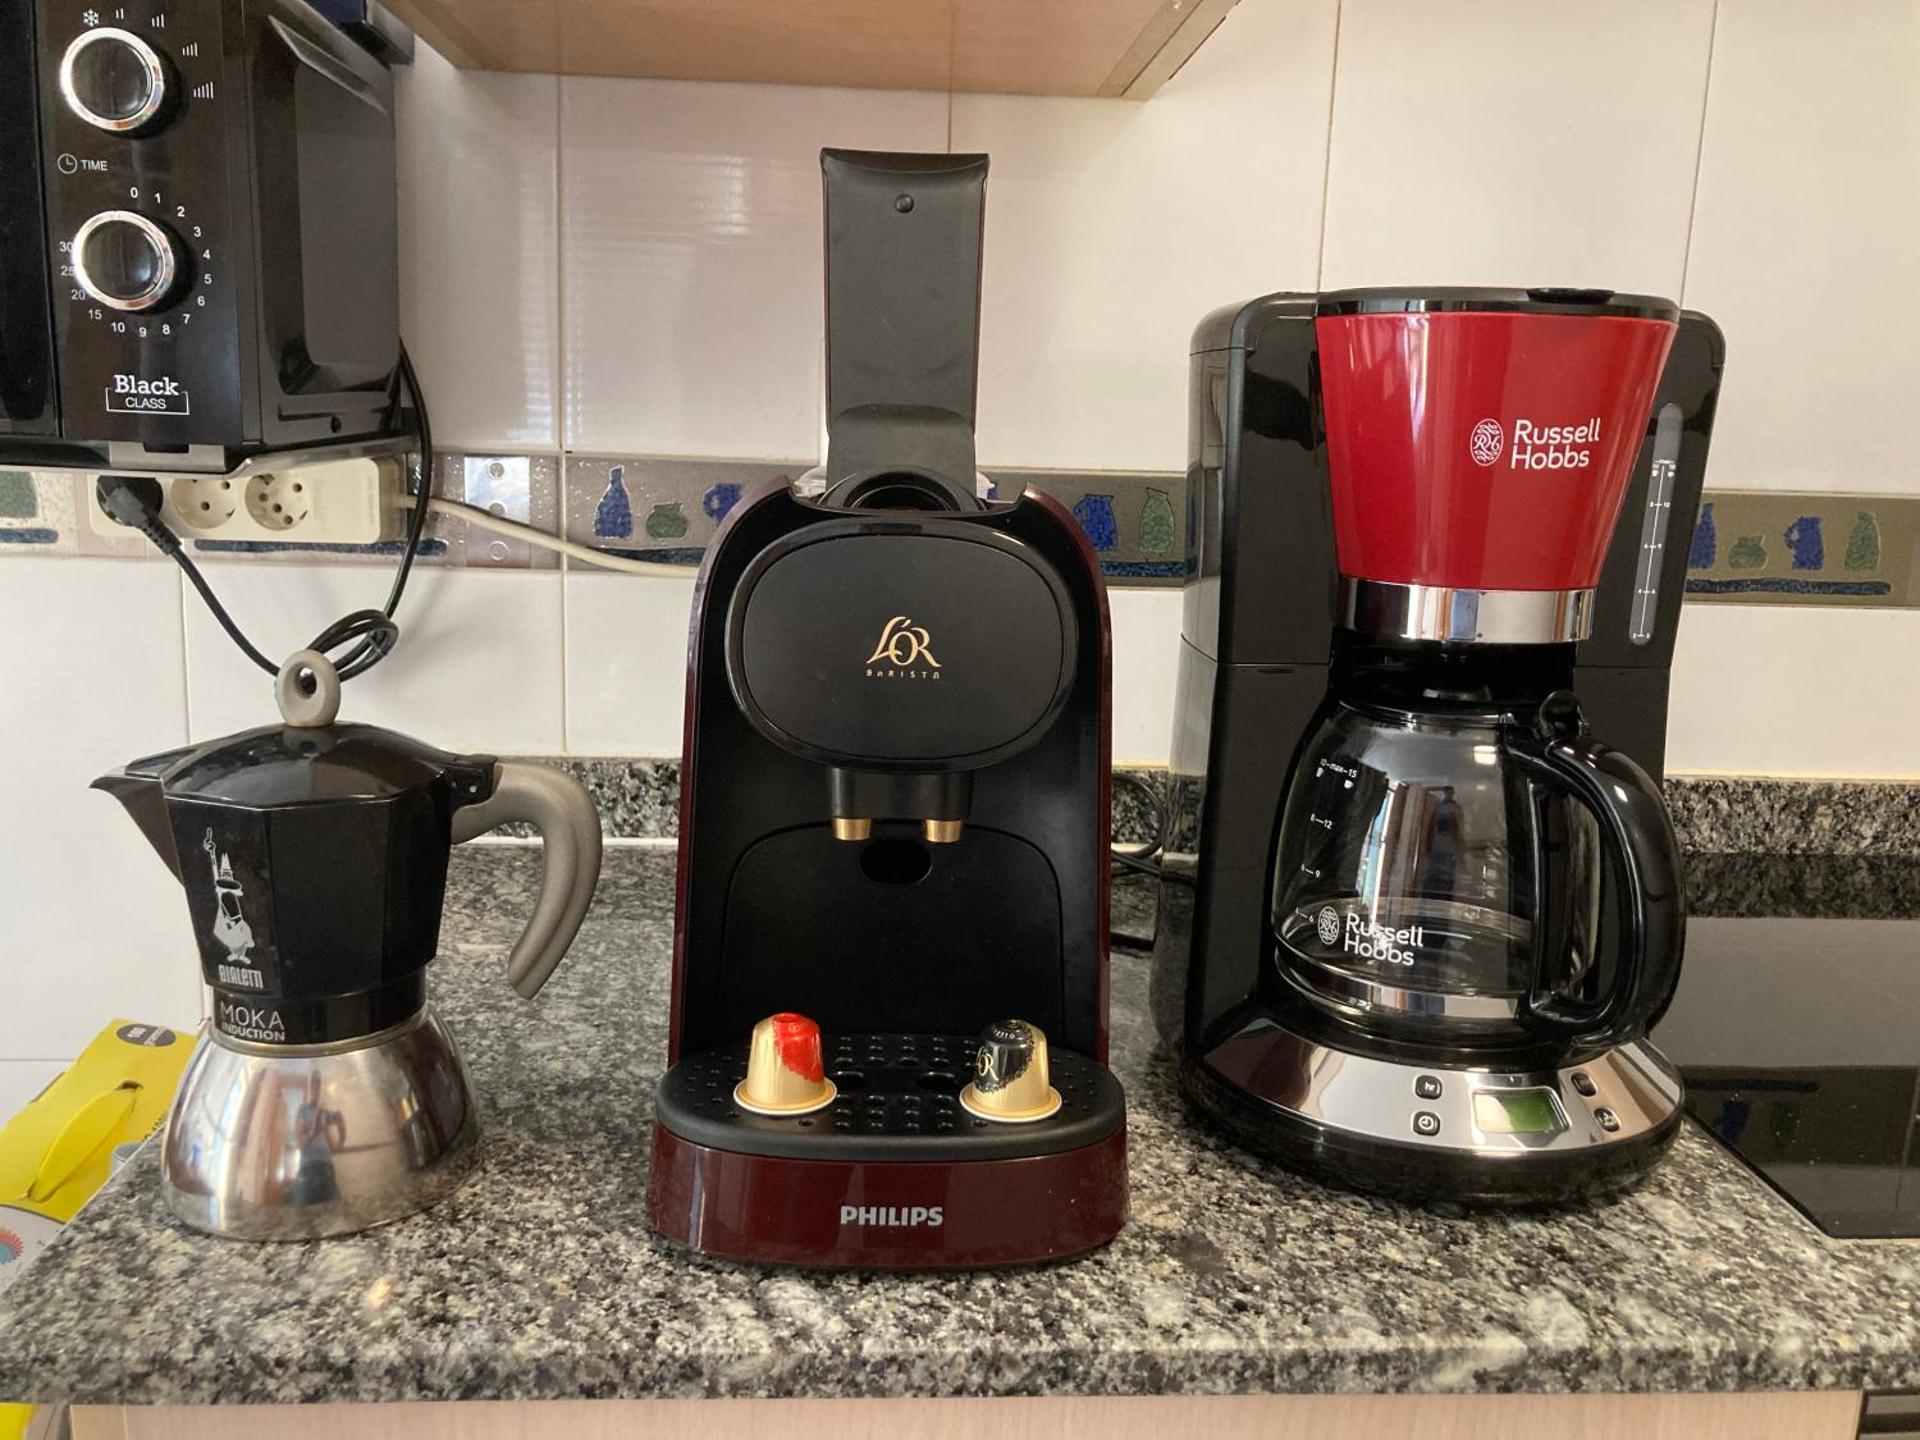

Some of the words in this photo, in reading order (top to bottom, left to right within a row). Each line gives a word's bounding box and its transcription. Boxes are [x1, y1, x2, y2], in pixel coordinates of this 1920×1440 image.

[81, 159, 108, 171] TIME
[130, 187, 139, 198] 0
[155, 193, 161, 204] 1
[177, 206, 185, 217] 2
[193, 226, 202, 237] 3
[59, 241, 74, 253] 30
[202, 249, 210, 260] 4
[204, 273, 212, 284] 5
[71, 289, 86, 300] 20
[197, 295, 206, 306] 6
[88, 309, 103, 320] 15
[182, 314, 191, 324] 7
[111, 322, 126, 333] 10
[139, 327, 147, 337] 9
[162, 324, 171, 335] 8
[114, 374, 180, 396] Black
[125, 396, 167, 410] CLASS
[1513, 416, 1602, 444] Russell
[1510, 444, 1591, 470] Hobbs
[865, 668, 941, 680] BARISTA
[1346, 911, 1425, 949] Russell
[1343, 931, 1415, 967] Hobbs
[217, 963, 265, 990] BIALETTI
[220, 1000, 286, 1031] MOKA
[220, 1020, 286, 1042] INDUCTION
[840, 1204, 944, 1227] PHILIPS
